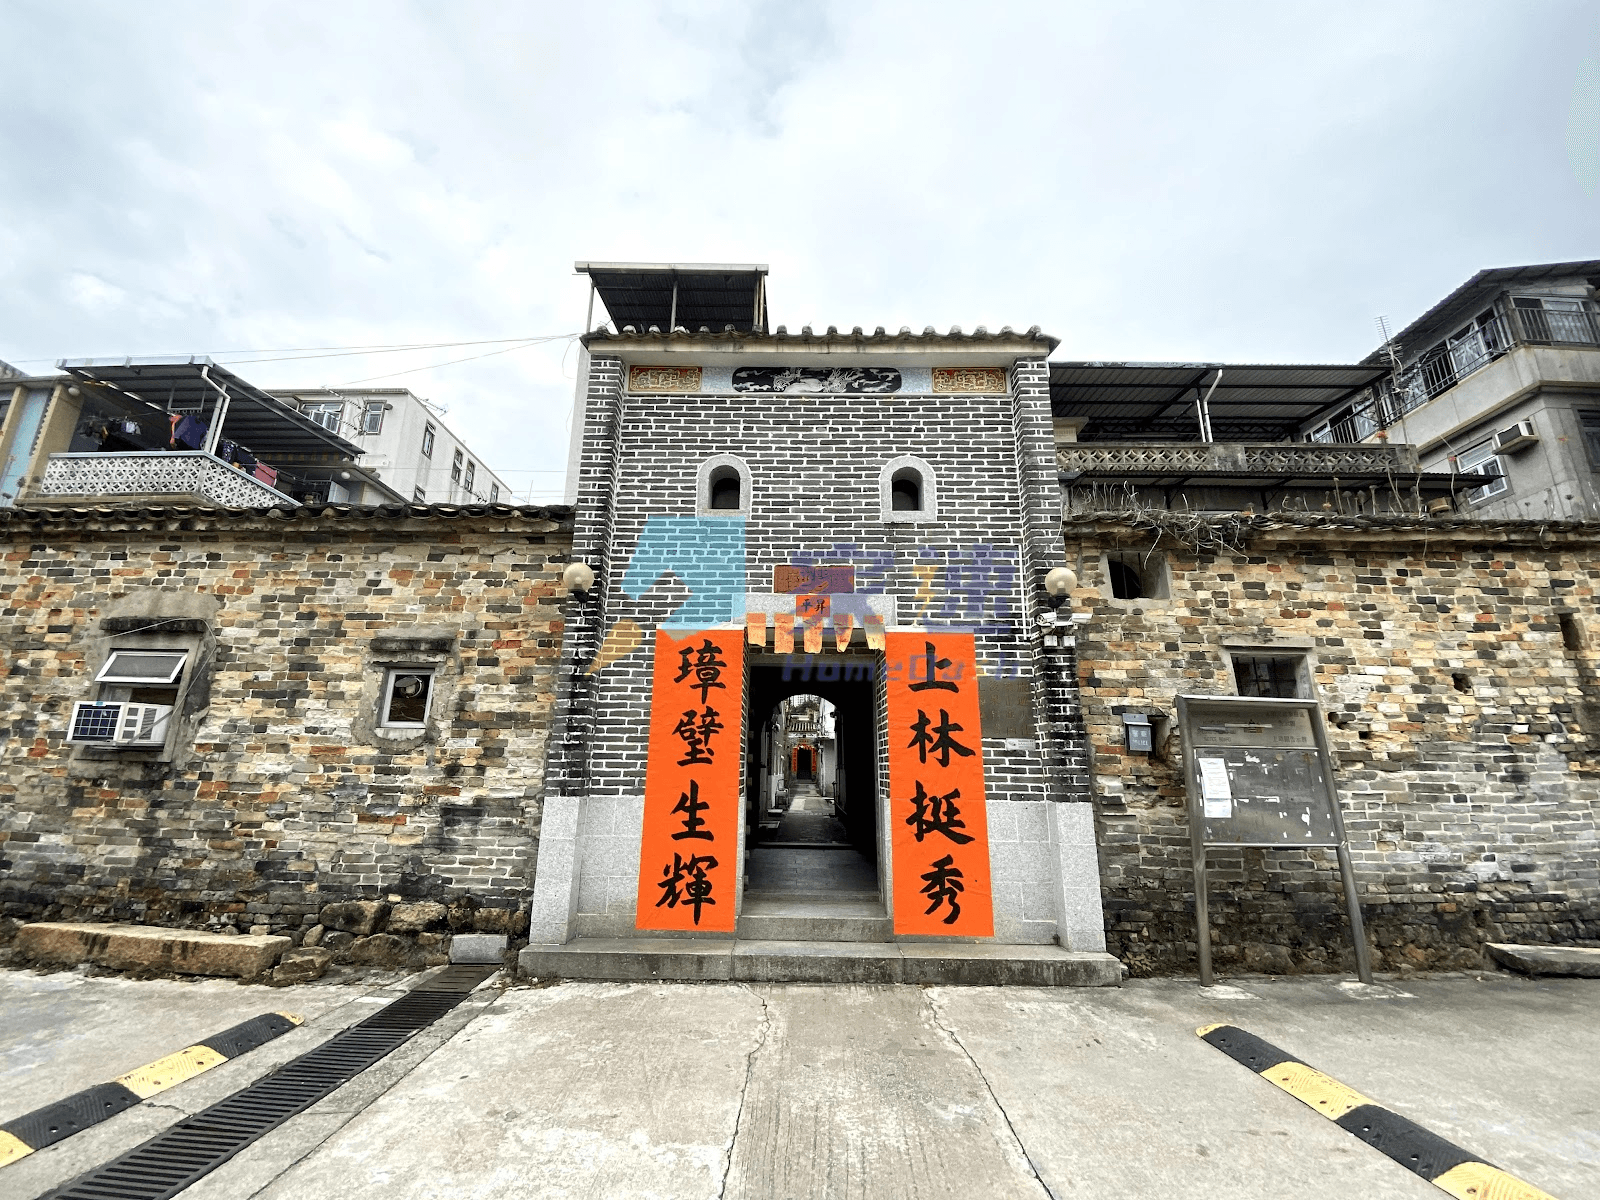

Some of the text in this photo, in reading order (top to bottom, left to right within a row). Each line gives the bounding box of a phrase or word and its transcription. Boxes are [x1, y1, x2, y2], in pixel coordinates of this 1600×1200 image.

[655, 639, 727, 925] 璋璧生輝
[905, 641, 976, 924] 上林挺秀
